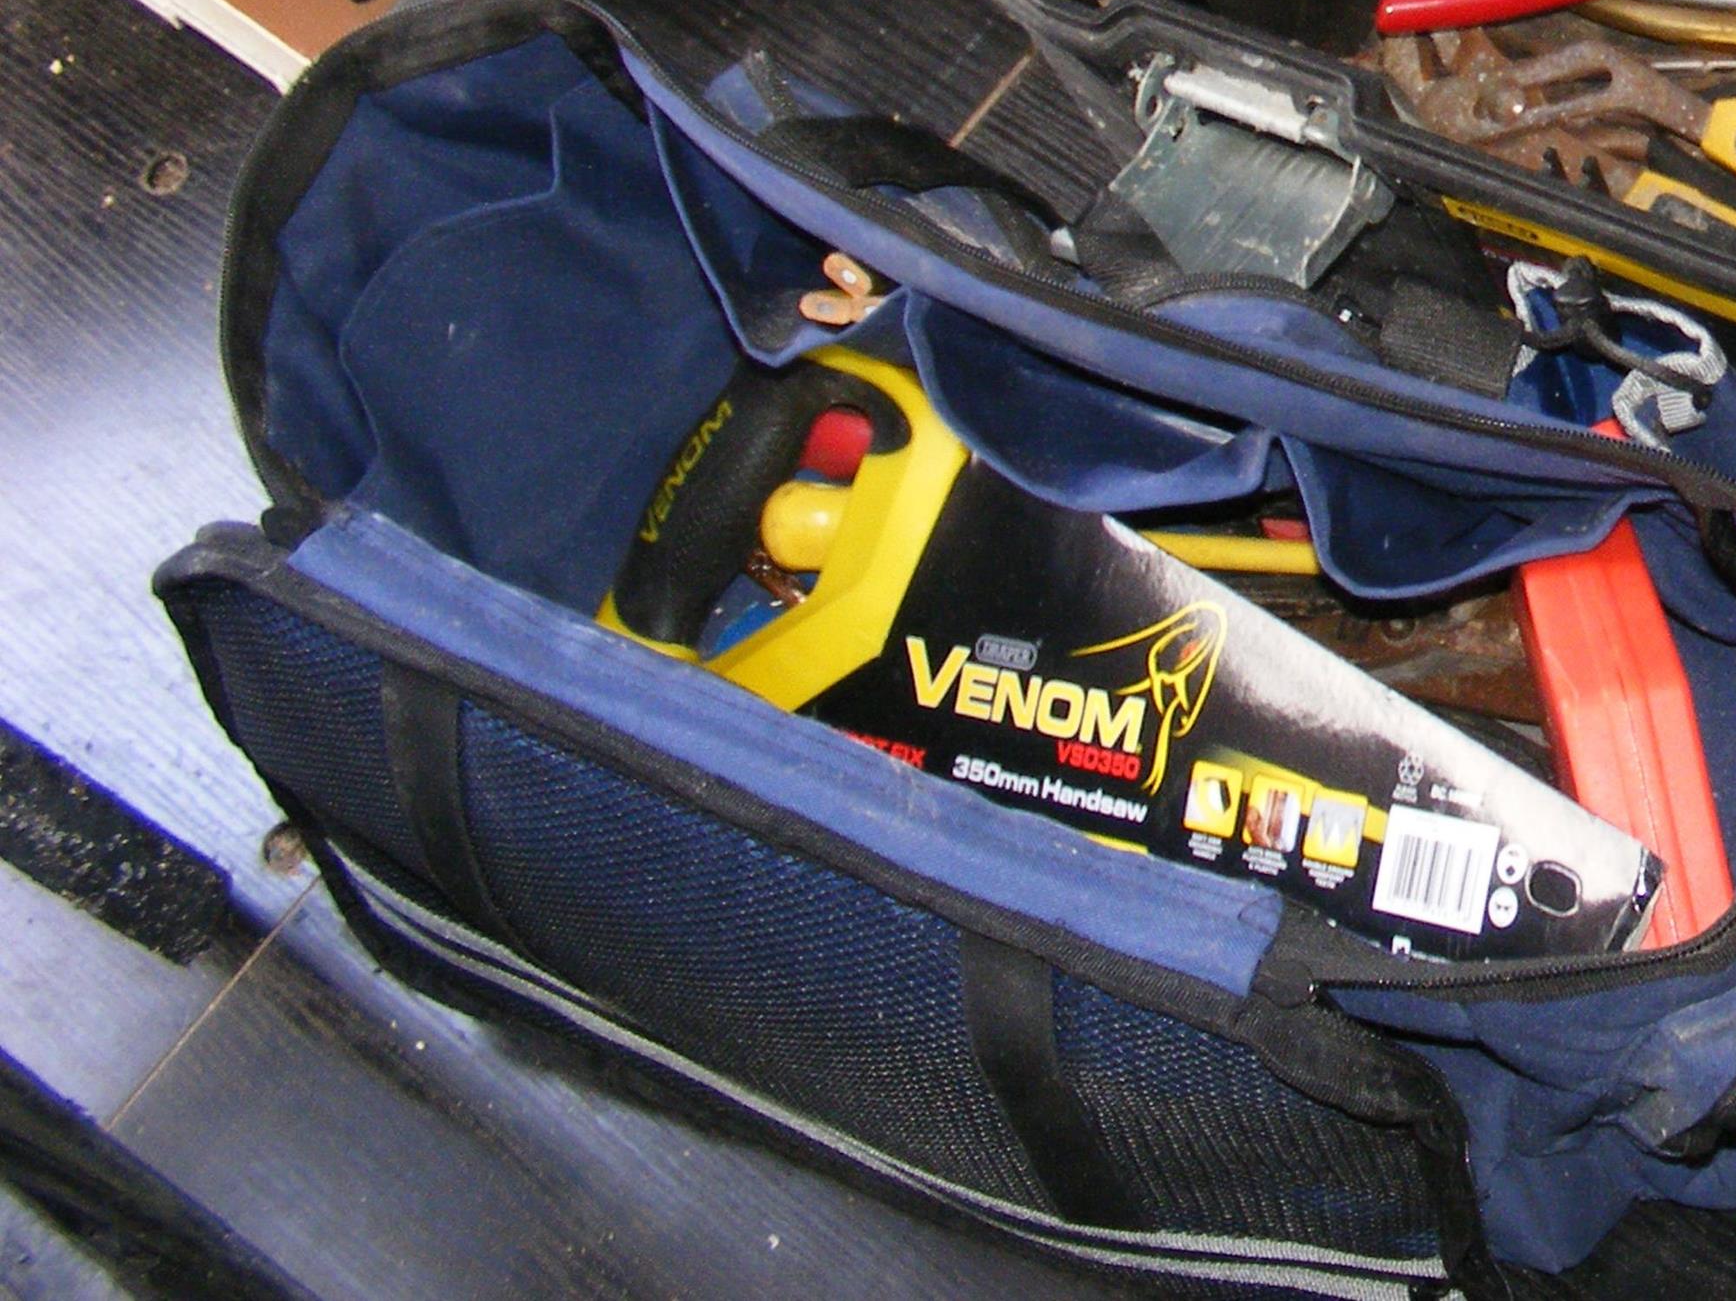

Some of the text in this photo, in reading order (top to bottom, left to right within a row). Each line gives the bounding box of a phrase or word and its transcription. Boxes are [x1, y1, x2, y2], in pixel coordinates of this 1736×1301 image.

[640, 401, 732, 542] VENOM
[905, 635, 1147, 754] VENOM
[951, 754, 1148, 823] 350mm Handsaw
[1056, 741, 1142, 780] VSD350
